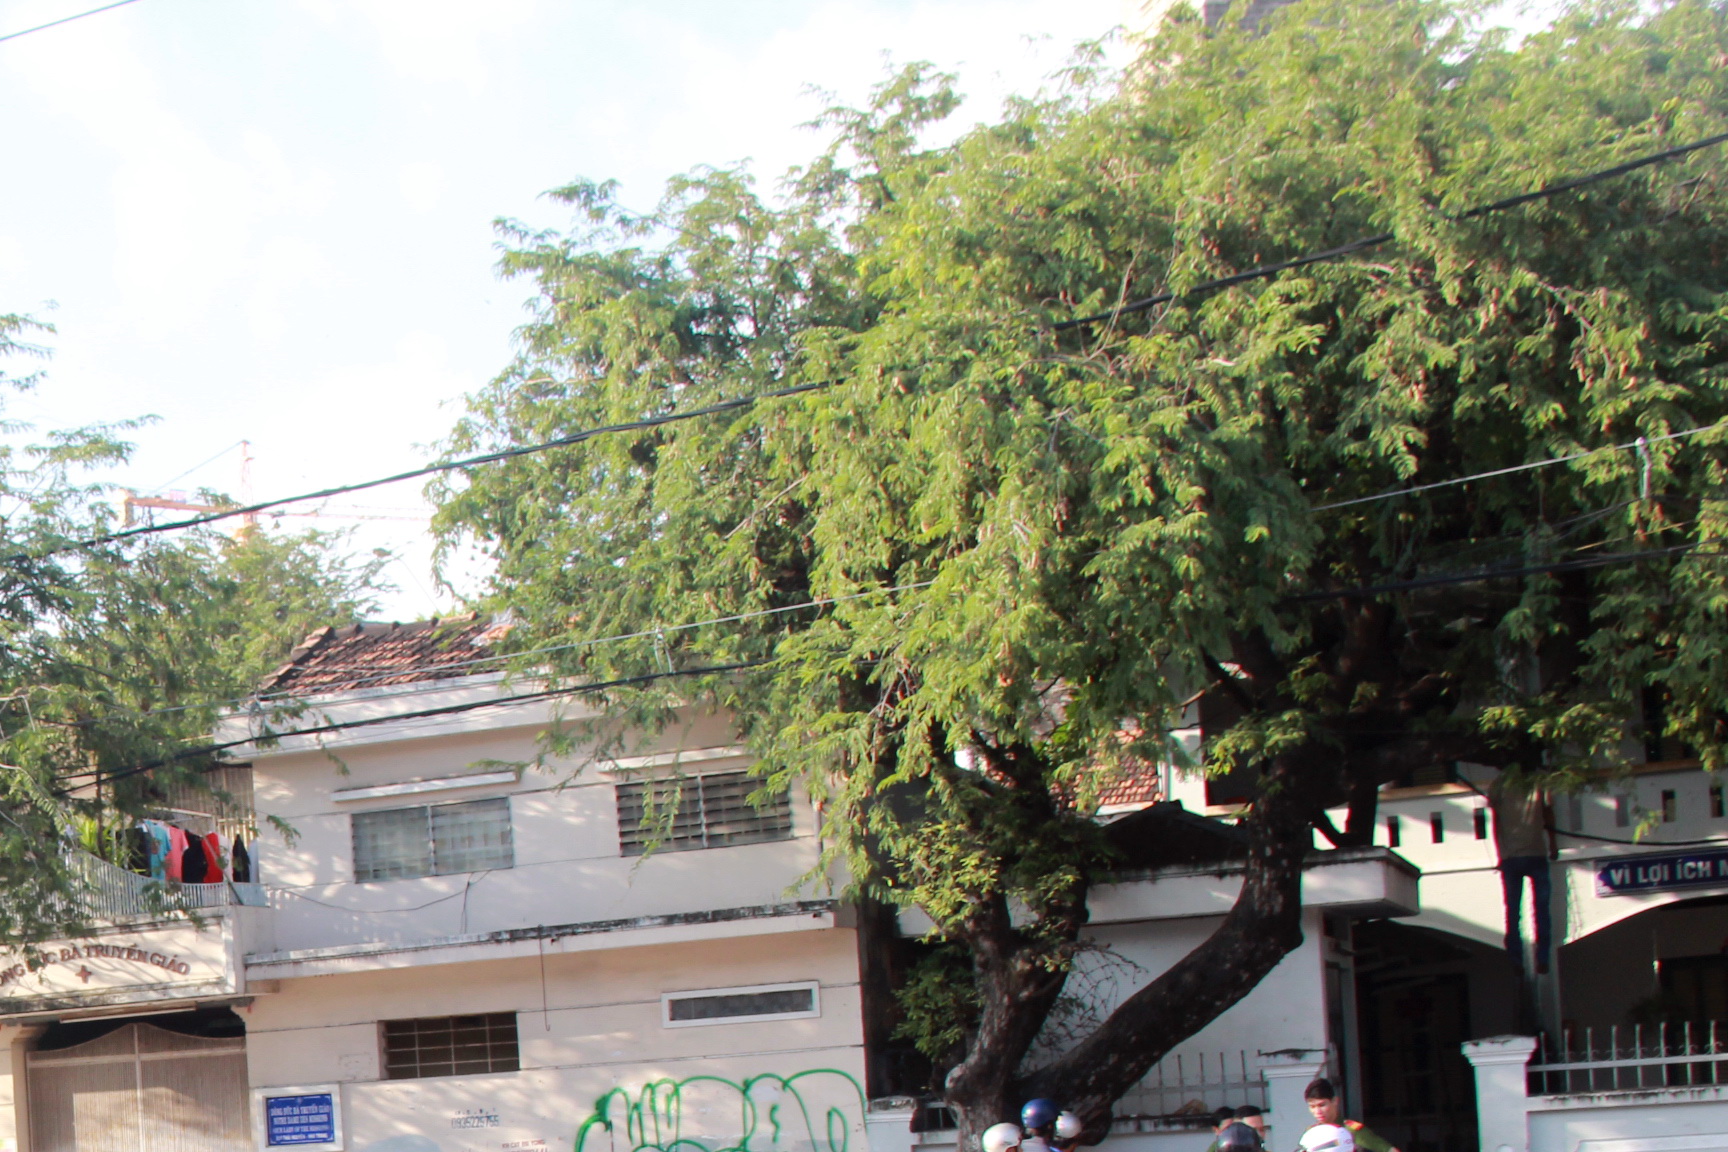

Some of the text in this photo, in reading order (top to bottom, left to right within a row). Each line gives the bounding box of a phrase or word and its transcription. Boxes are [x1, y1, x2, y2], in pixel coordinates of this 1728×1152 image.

[1610, 864, 1630, 886] VÌ
[1637, 863, 1669, 886] LỢI
[1676, 859, 1712, 879] ÍCH
